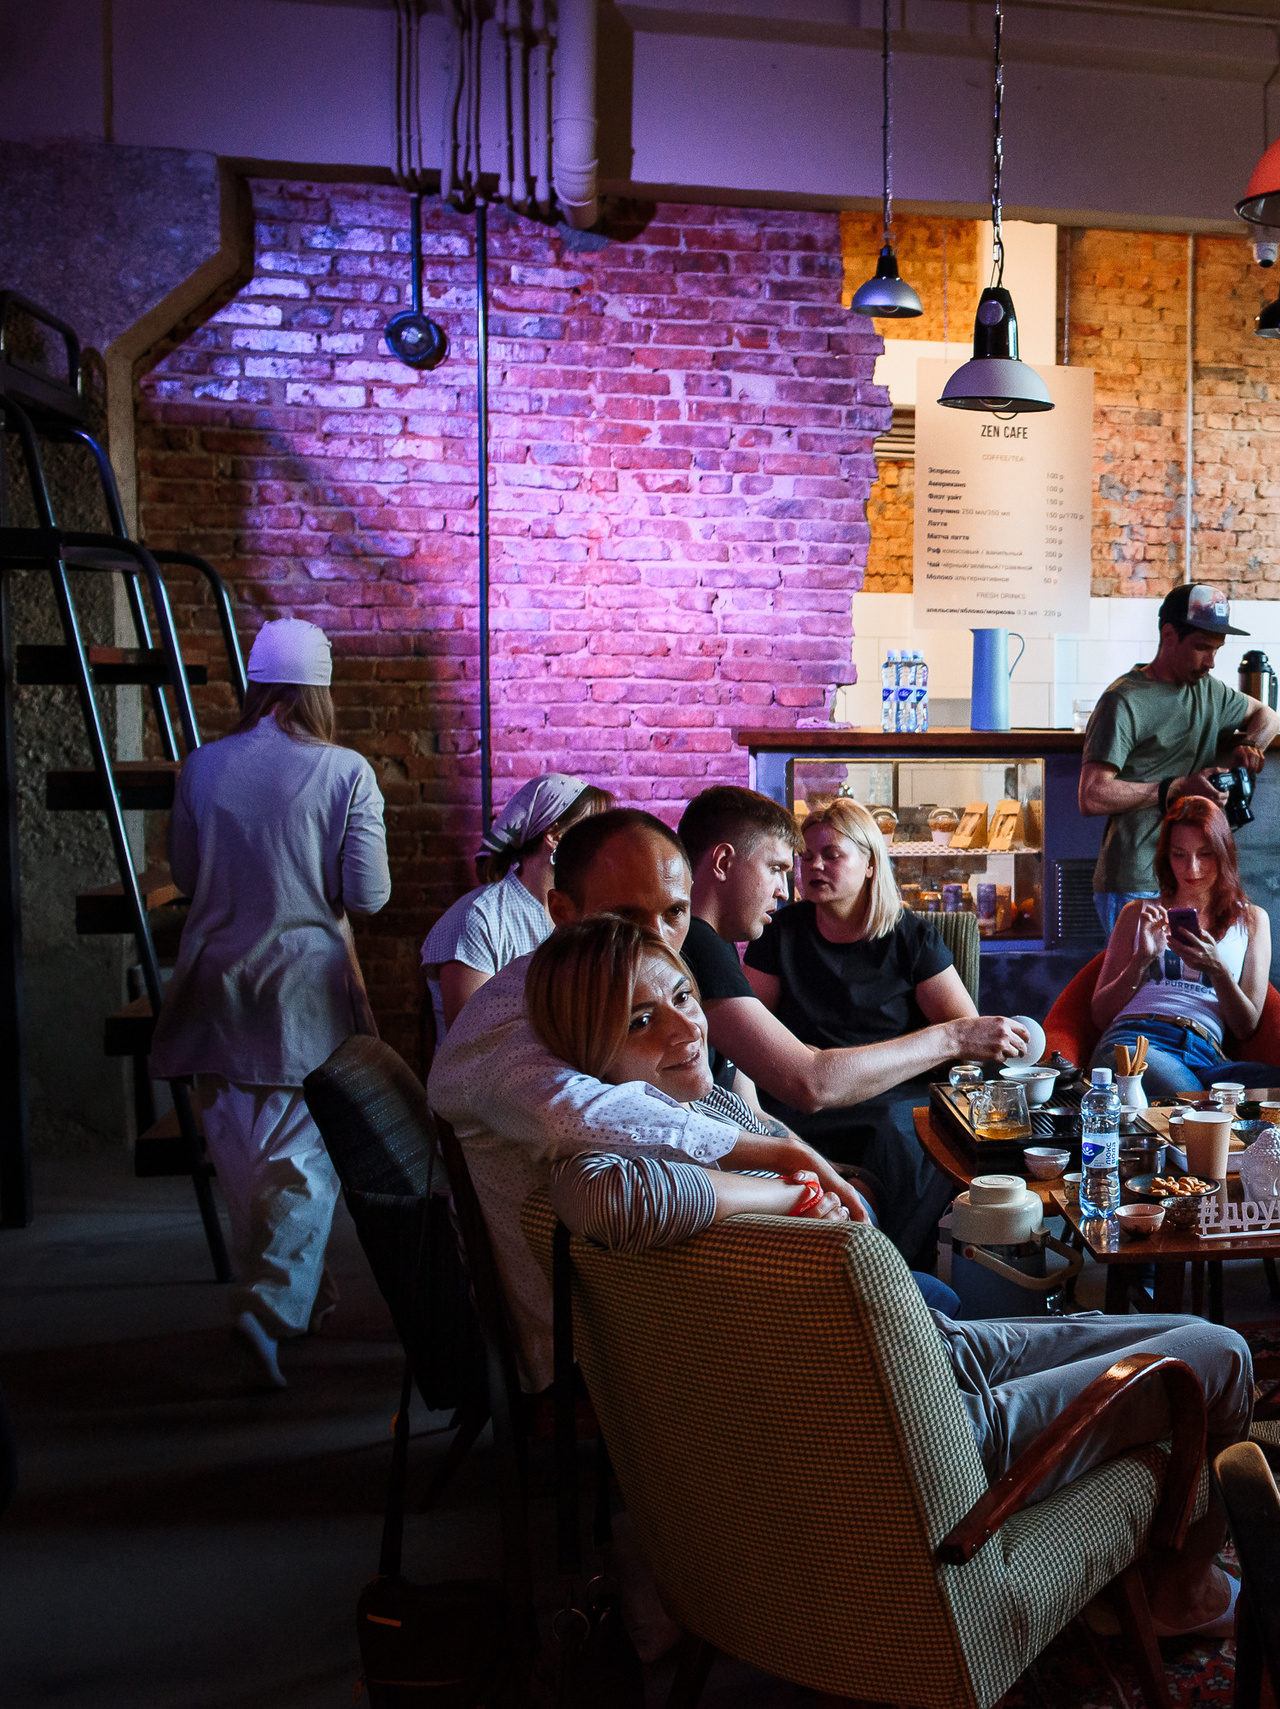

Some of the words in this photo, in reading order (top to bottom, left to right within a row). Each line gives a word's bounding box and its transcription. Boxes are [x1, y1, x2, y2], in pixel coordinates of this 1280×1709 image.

[980, 424, 1000, 438] ZEN
[1003, 425, 1029, 440] CAFE
[982, 454, 1025, 462] COFFEE/TEA
[927, 466, 961, 475] Эспрессо
[927, 479, 967, 488] Американо
[927, 492, 946, 500] Флэт
[947, 493, 963, 502] уайт
[926, 506, 961, 515] Капучино
[927, 519, 948, 527] Латте
[926, 532, 949, 540] Матча
[926, 546, 941, 555] Раф
[926, 560, 941, 568] Чай
[926, 573, 954, 581] Молоко
[976, 591, 999, 599] FRESH
[1000, 592, 1026, 600] DRINKS
